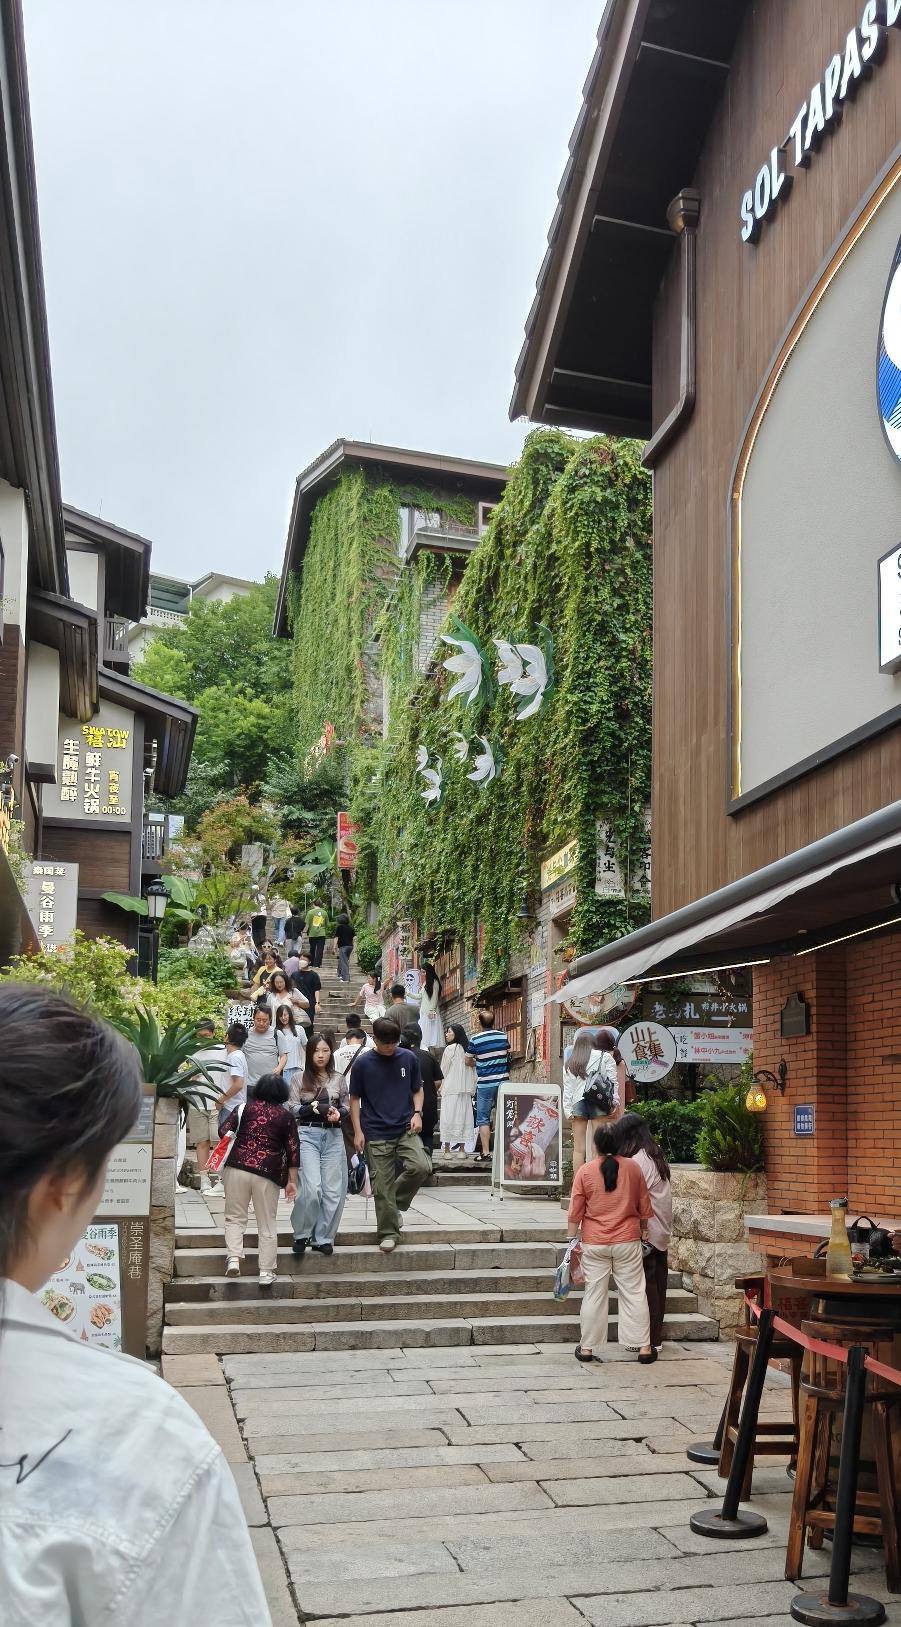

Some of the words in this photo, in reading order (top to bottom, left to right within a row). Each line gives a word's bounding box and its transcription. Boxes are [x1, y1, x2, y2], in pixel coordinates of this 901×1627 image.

[741, 147, 785, 242] SOL
[789, 0, 879, 167] TAPAS
[82, 725, 129, 739] SWATOW
[83, 751, 102, 814] 鲜牛火锅
[108, 770, 119, 805] 宵夜至
[102, 806, 127, 815] 00:00
[32, 865, 66, 876] 泰国菜
[38, 881, 56, 938] 曼谷雨季
[632, 1042, 665, 1061] 食集
[127, 1221, 144, 1279] 崇圣庵巷
